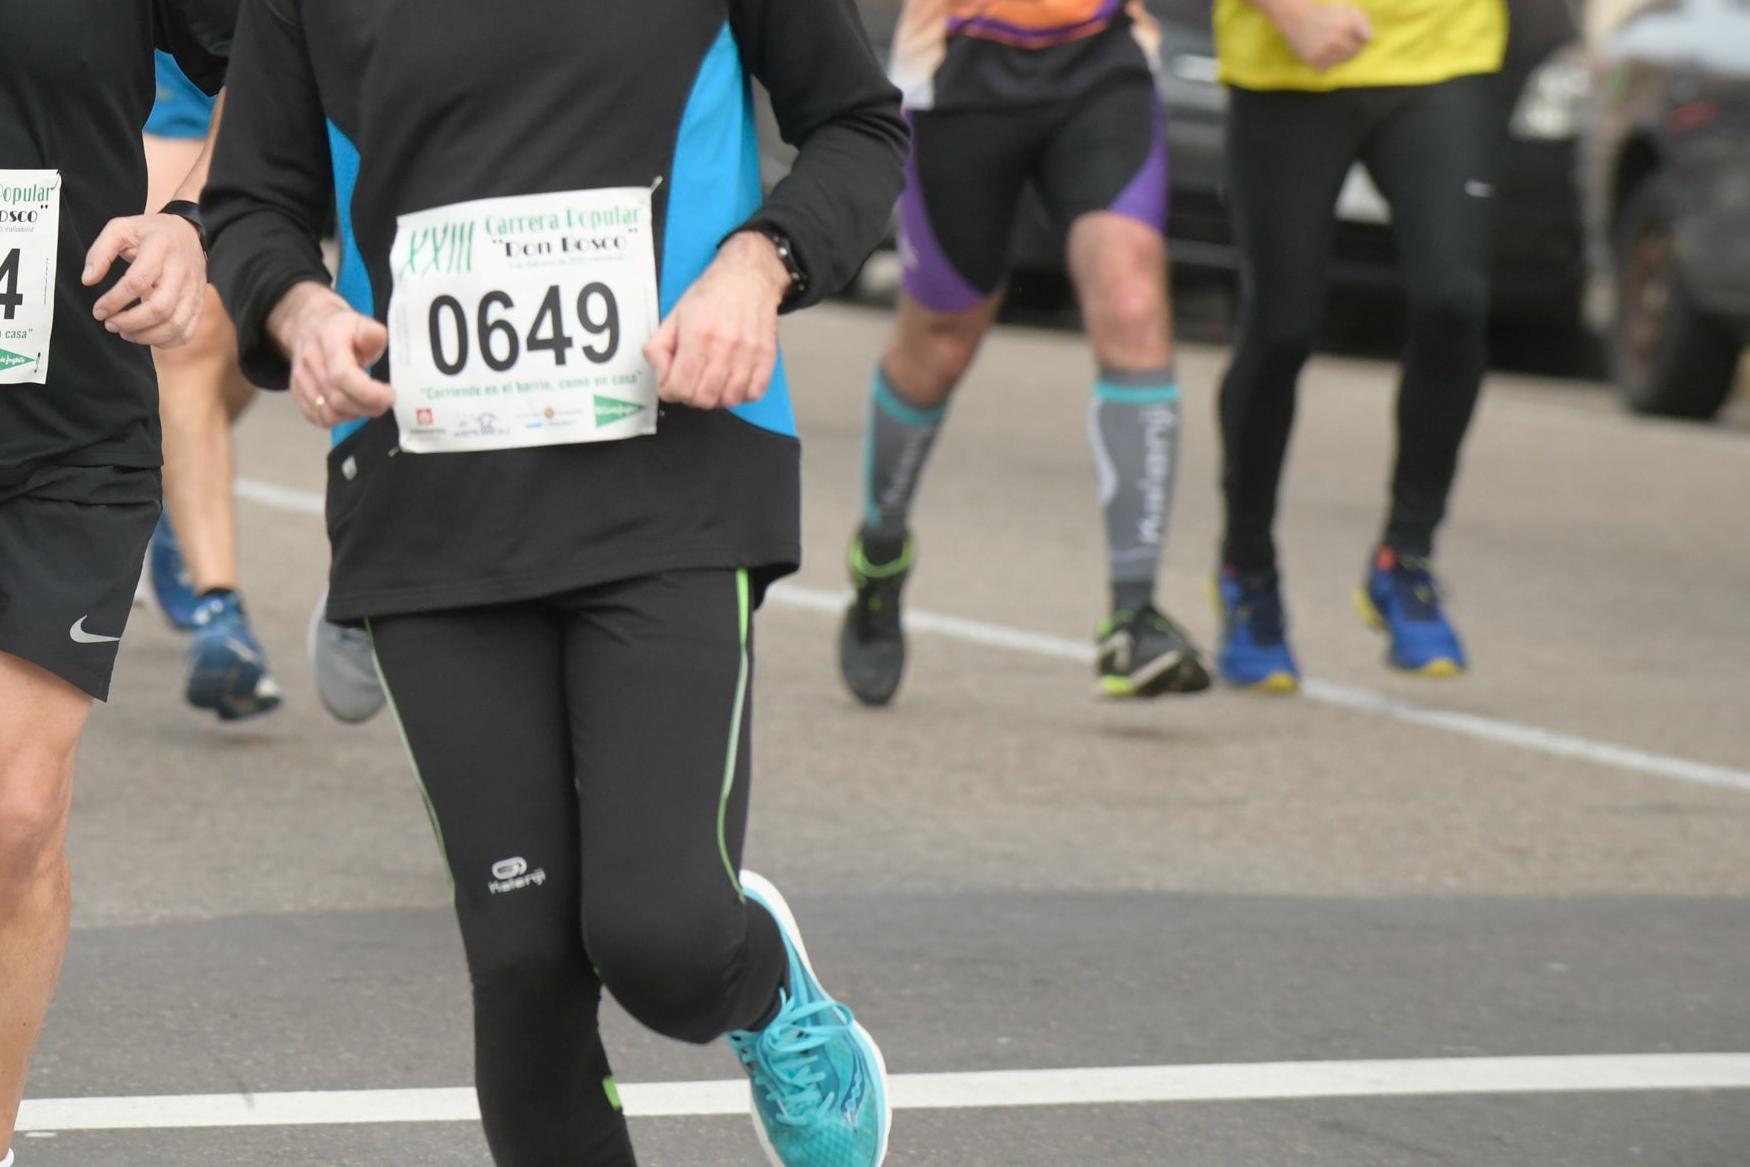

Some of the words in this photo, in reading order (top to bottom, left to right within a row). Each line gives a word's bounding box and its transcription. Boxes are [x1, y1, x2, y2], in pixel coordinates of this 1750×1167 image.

[399, 221, 475, 279] XXIII
[485, 214, 559, 235] Carrera
[566, 205, 638, 230] Popular
[428, 281, 620, 376] 0649
